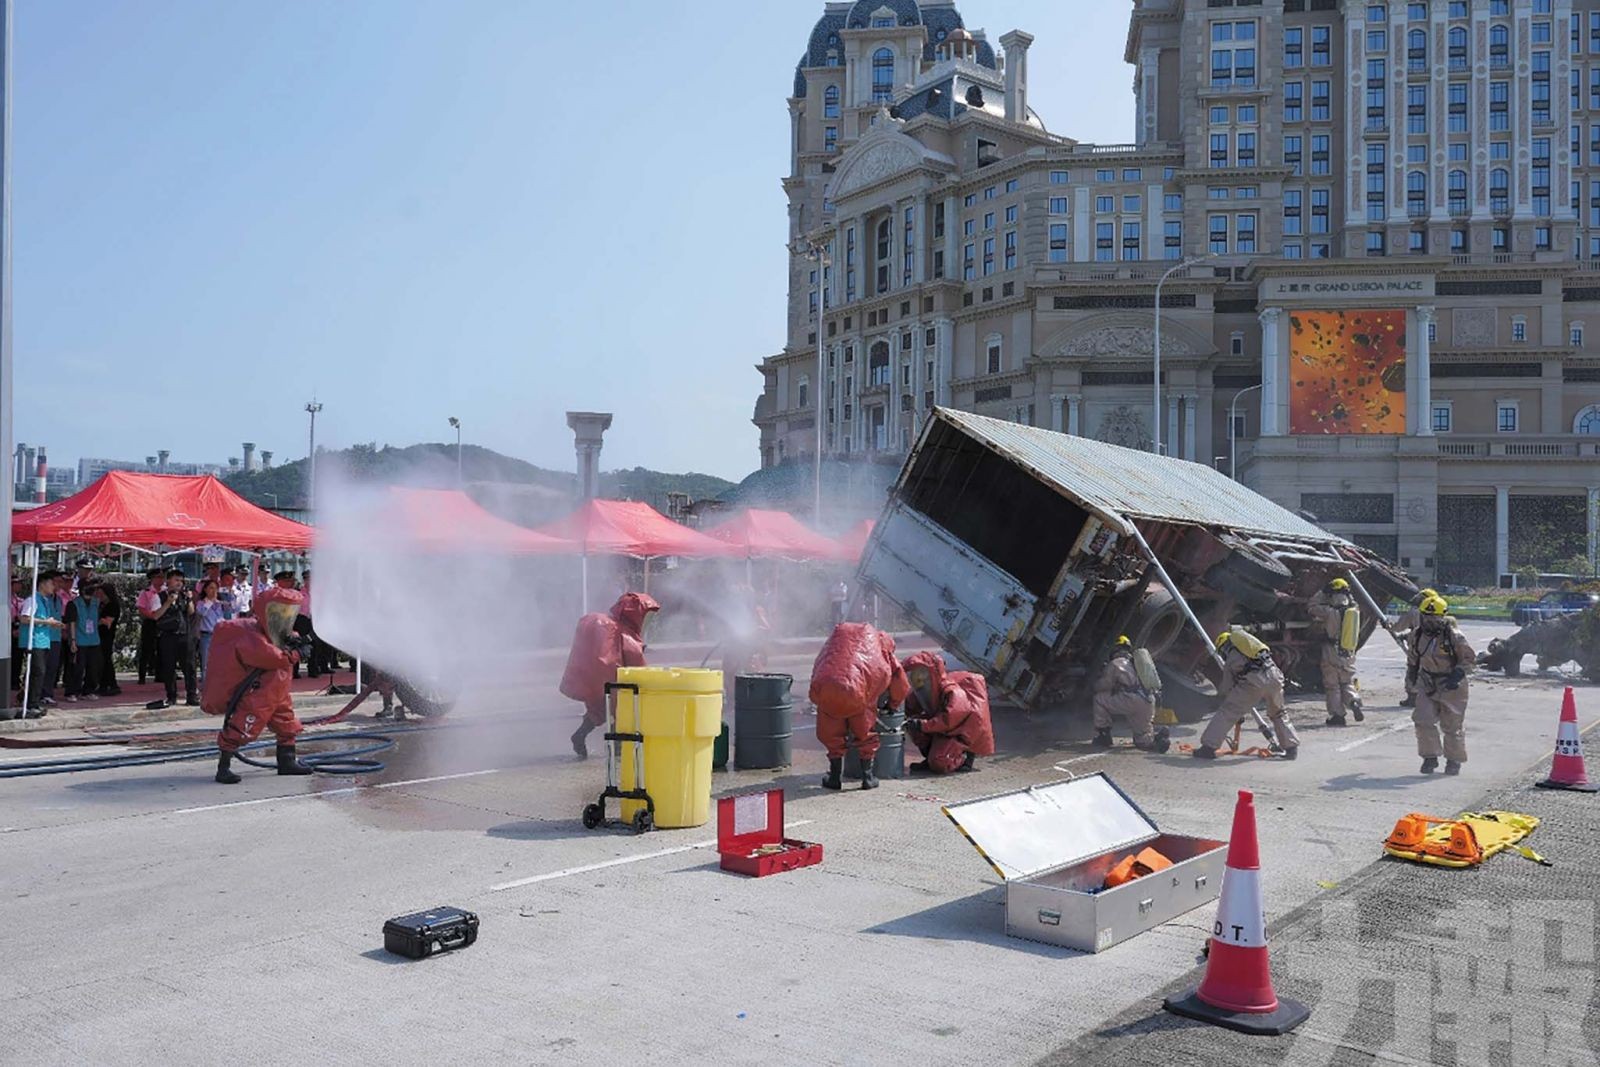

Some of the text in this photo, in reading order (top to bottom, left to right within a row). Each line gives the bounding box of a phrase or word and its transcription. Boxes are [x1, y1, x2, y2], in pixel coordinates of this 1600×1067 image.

[1314, 281, 1422, 292] GRAND LISBOA PALACE
